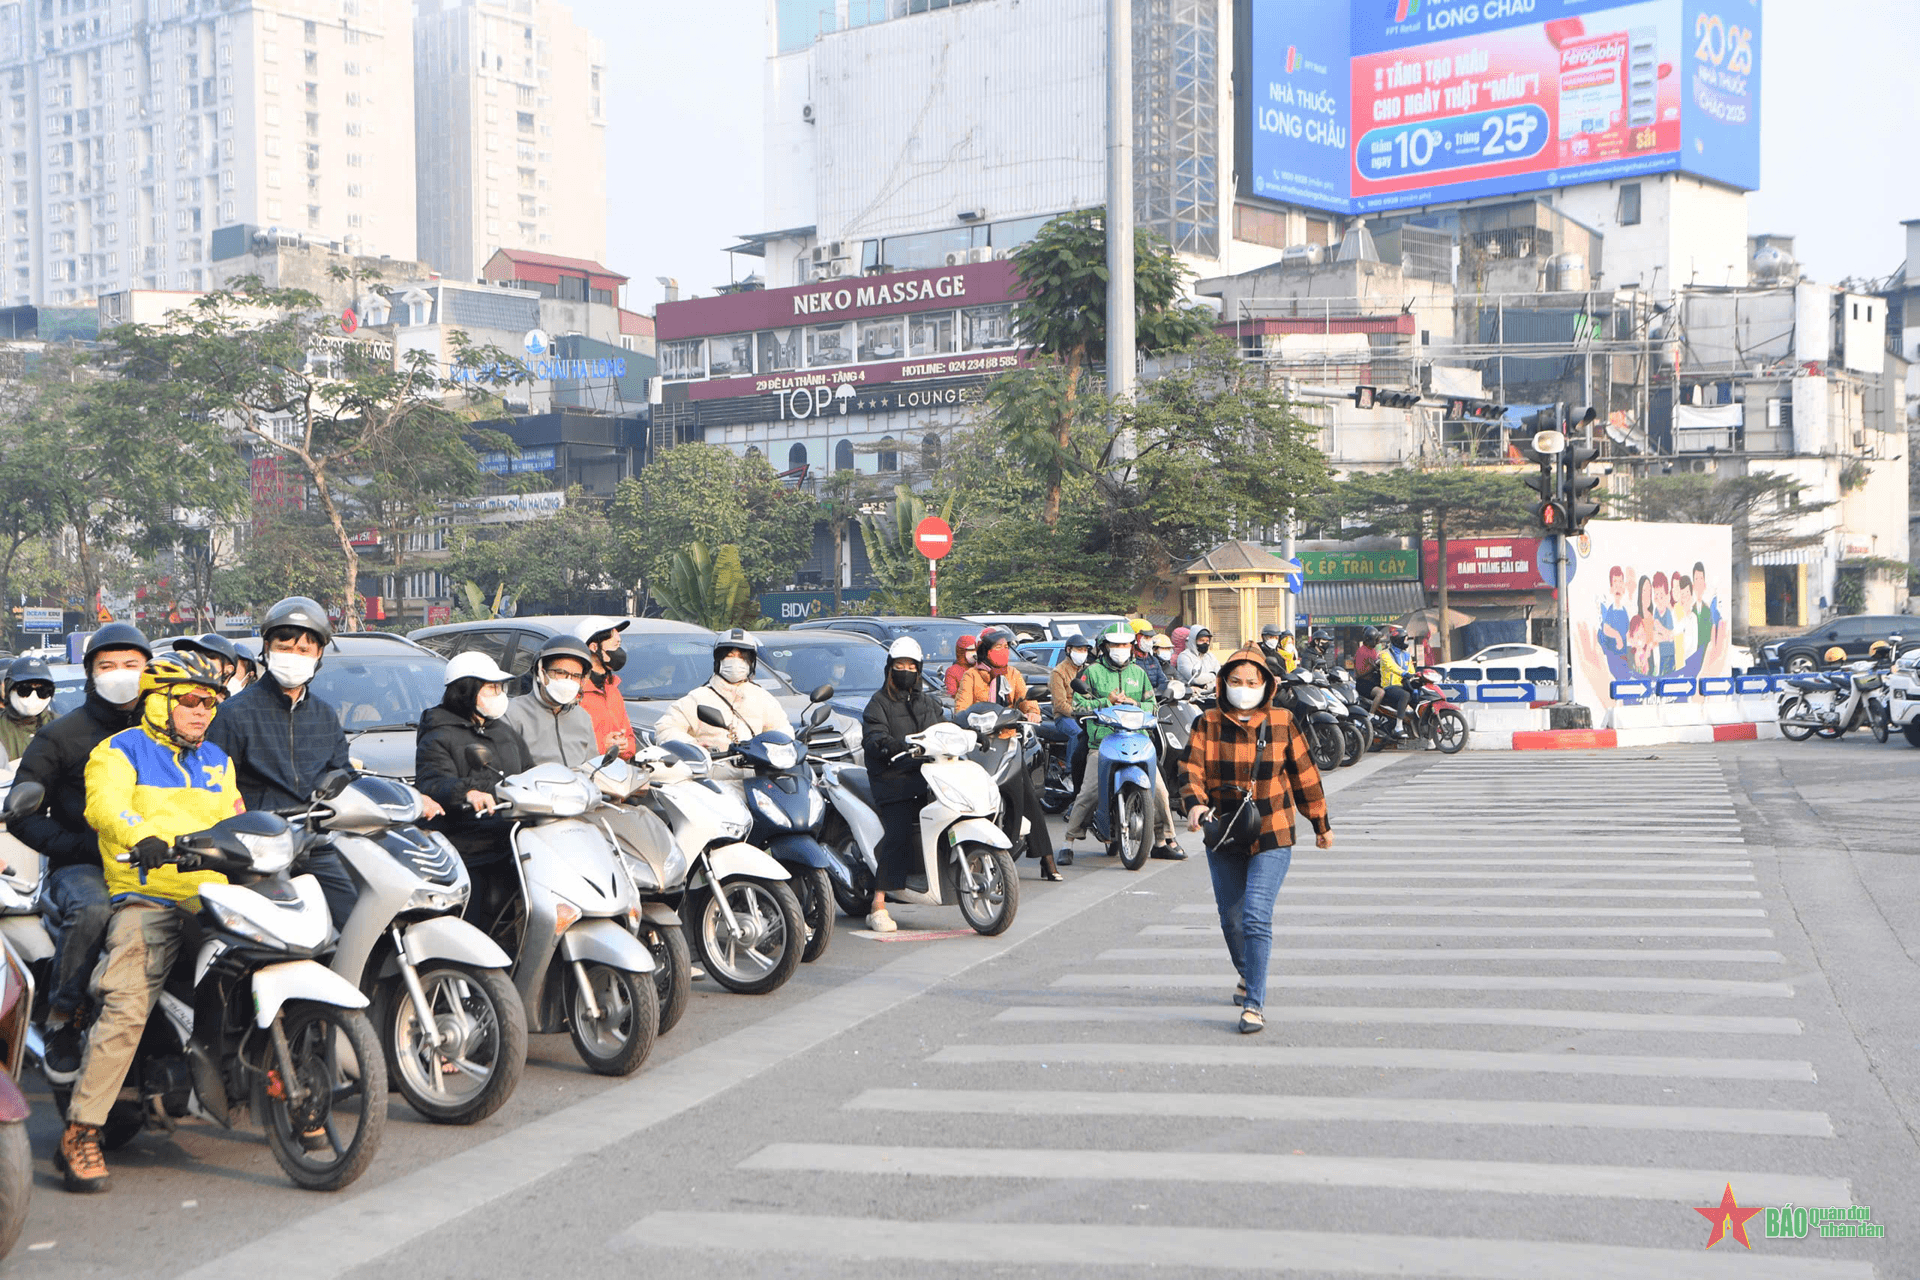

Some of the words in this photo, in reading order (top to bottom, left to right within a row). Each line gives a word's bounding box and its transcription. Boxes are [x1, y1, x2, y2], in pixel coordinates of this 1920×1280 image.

[1427, 5, 1479, 32] LONG
[1425, 57, 1451, 85] TẠO
[1270, 81, 1295, 105] NHÀ
[1297, 89, 1336, 115] THUỐC
[1373, 96, 1400, 121] CHO
[1404, 87, 1441, 116] NGÀY
[1259, 106, 1302, 138] LONG
[1305, 118, 1346, 149] CHÂU
[793, 289, 852, 315] NEKO
[856, 274, 966, 307] MASSAGE
[538, 353, 569, 381] CHÂU
[571, 359, 588, 383] HẠ
[591, 357, 626, 379] LONG
[756, 381, 767, 391] 29
[768, 377, 781, 390] ĐÊ
[782, 378, 794, 389] LA
[794, 374, 826, 387] THÀNH
[858, 370, 866, 381] 4
[902, 363, 946, 377] HOTLINE:
[948, 361, 967, 373] 024
[967, 358, 985, 370] 234
[999, 356, 1018, 367] 585
[773, 385, 832, 420] TOP
[898, 388, 966, 407] LOUNGE
[781, 602, 811, 618] BIDV
